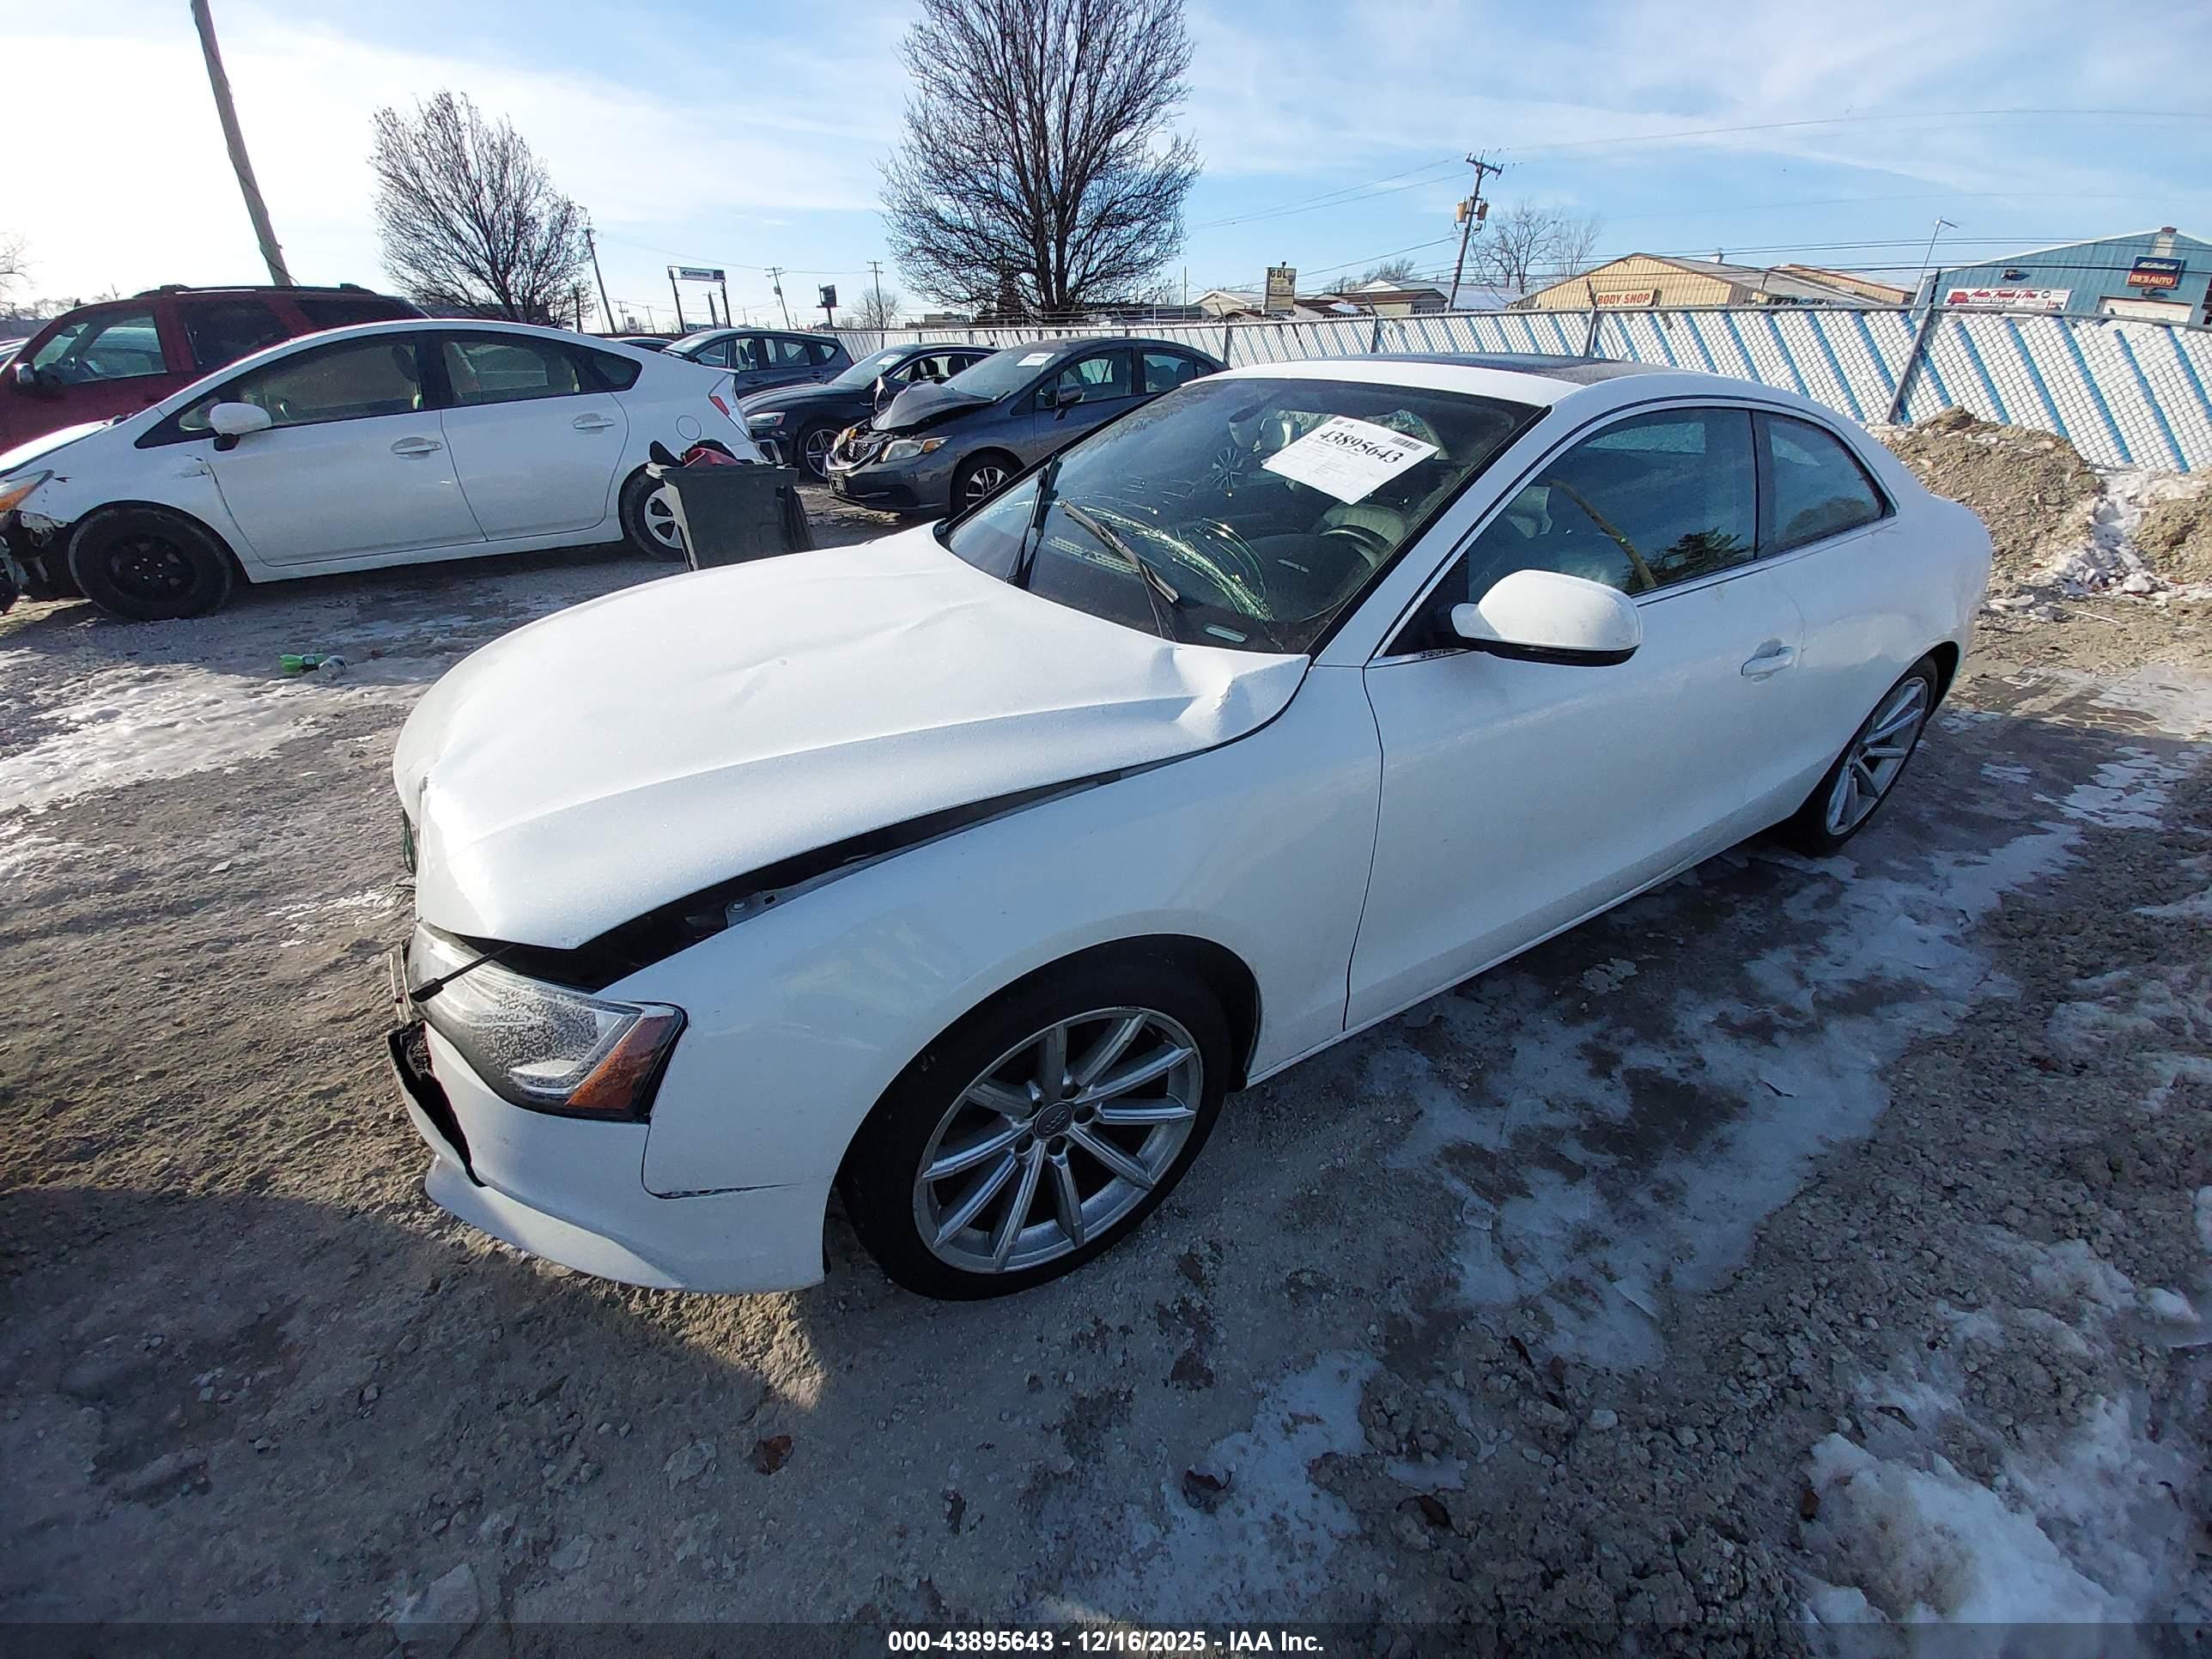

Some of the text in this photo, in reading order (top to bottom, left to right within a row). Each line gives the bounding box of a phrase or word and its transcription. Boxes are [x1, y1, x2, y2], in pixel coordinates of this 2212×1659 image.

[1271, 270, 1287, 278] GDL
[2149, 276, 2173, 284] AUTO
[1597, 294, 1650, 304] BODY SHOP
[1320, 430, 1404, 464] 43895643
